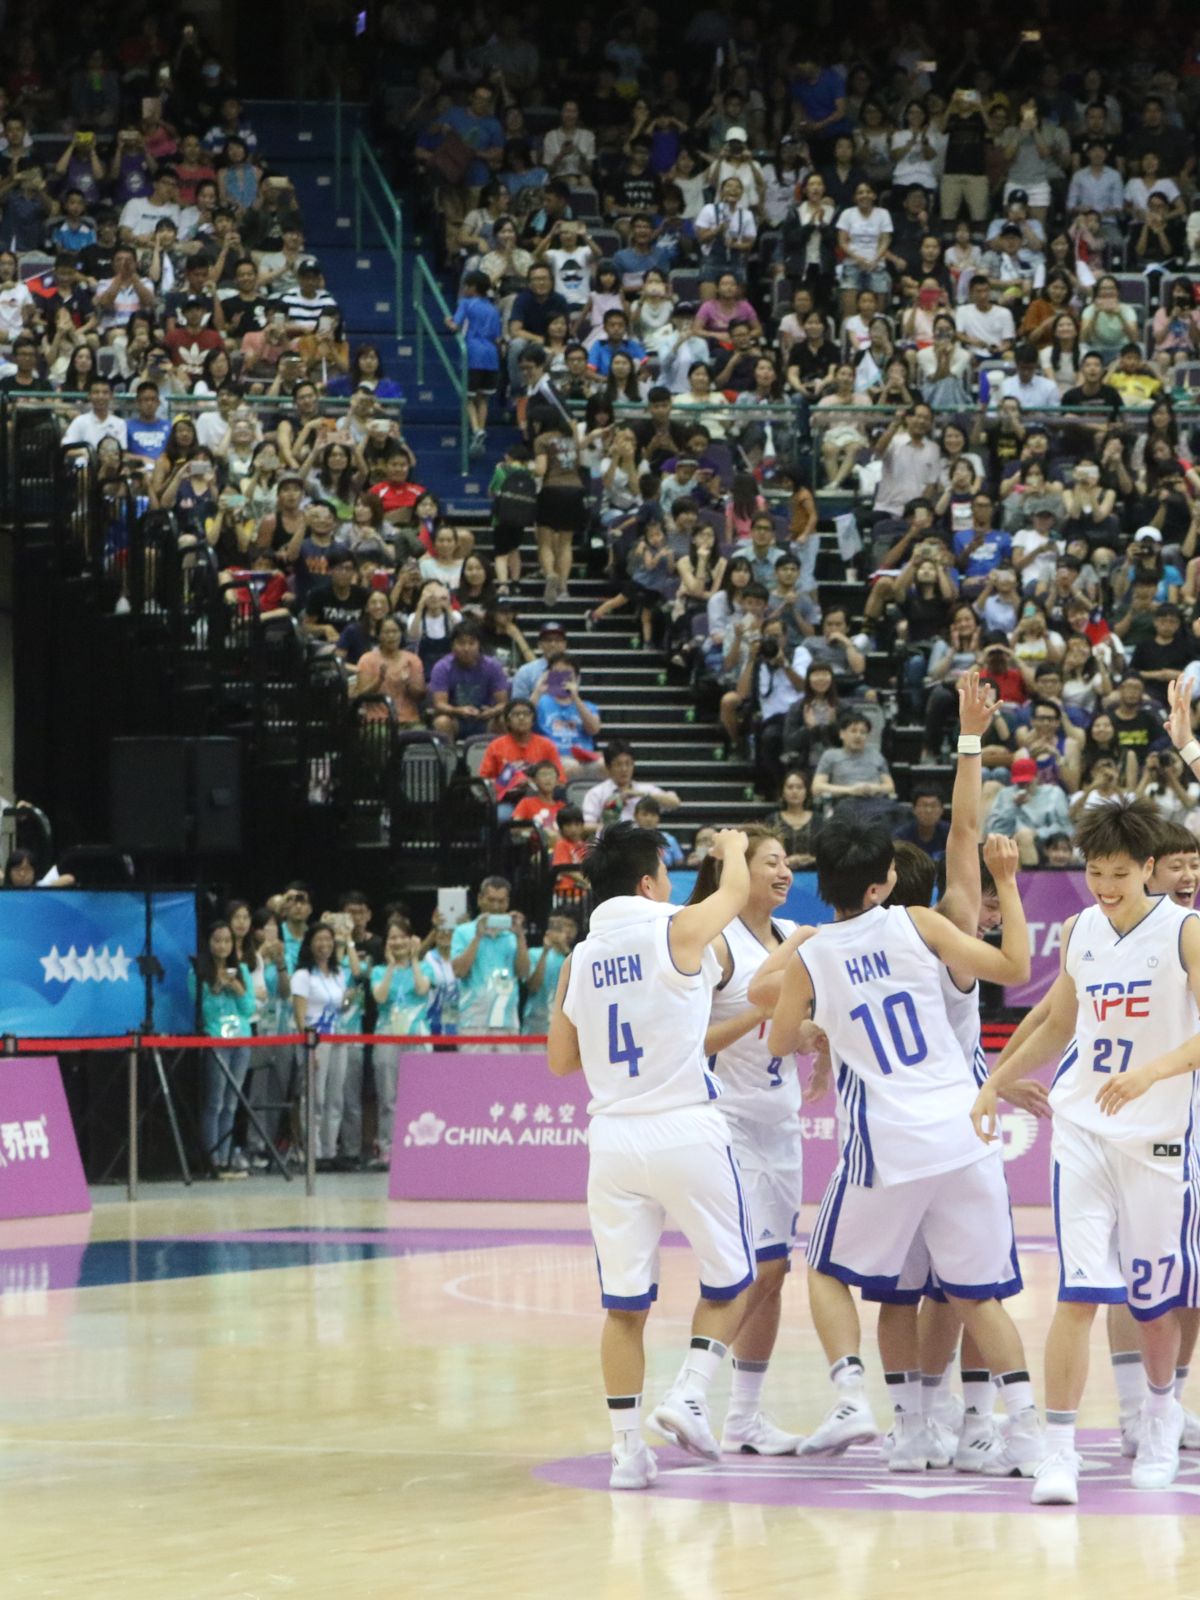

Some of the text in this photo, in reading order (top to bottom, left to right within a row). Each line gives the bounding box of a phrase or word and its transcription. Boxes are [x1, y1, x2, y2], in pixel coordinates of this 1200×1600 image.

[591, 953, 643, 989] CHEN
[844, 950, 892, 986] HAN
[1085, 979, 1153, 1022] TPE
[607, 1003, 644, 1078] 4
[849, 990, 929, 1076] 10
[1093, 1038, 1134, 1074] 27
[489, 1102, 576, 1125] 中華航空
[445, 1126, 514, 1146] CHINA
[1131, 1254, 1176, 1301] 27
